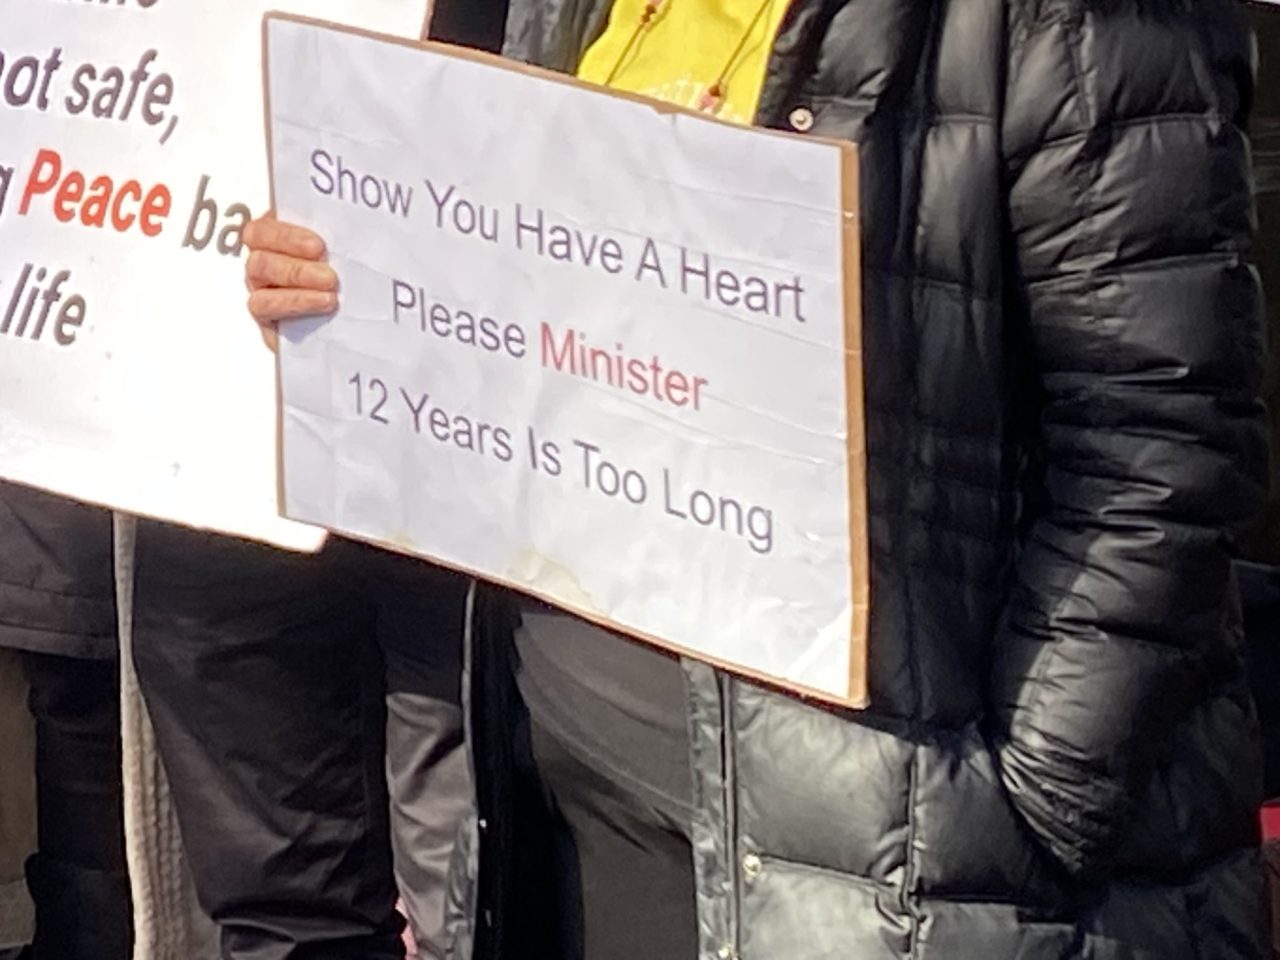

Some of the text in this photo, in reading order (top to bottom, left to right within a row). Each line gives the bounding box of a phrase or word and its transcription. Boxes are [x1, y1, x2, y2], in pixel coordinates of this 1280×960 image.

[64, 49, 181, 145] safe,
[18, 148, 172, 238] Peace
[310, 148, 807, 324] Show You Have A Heart
[0, 261, 87, 346] life
[391, 278, 709, 412] Please Minister
[348, 371, 773, 555] 12 Years Is Too Long
